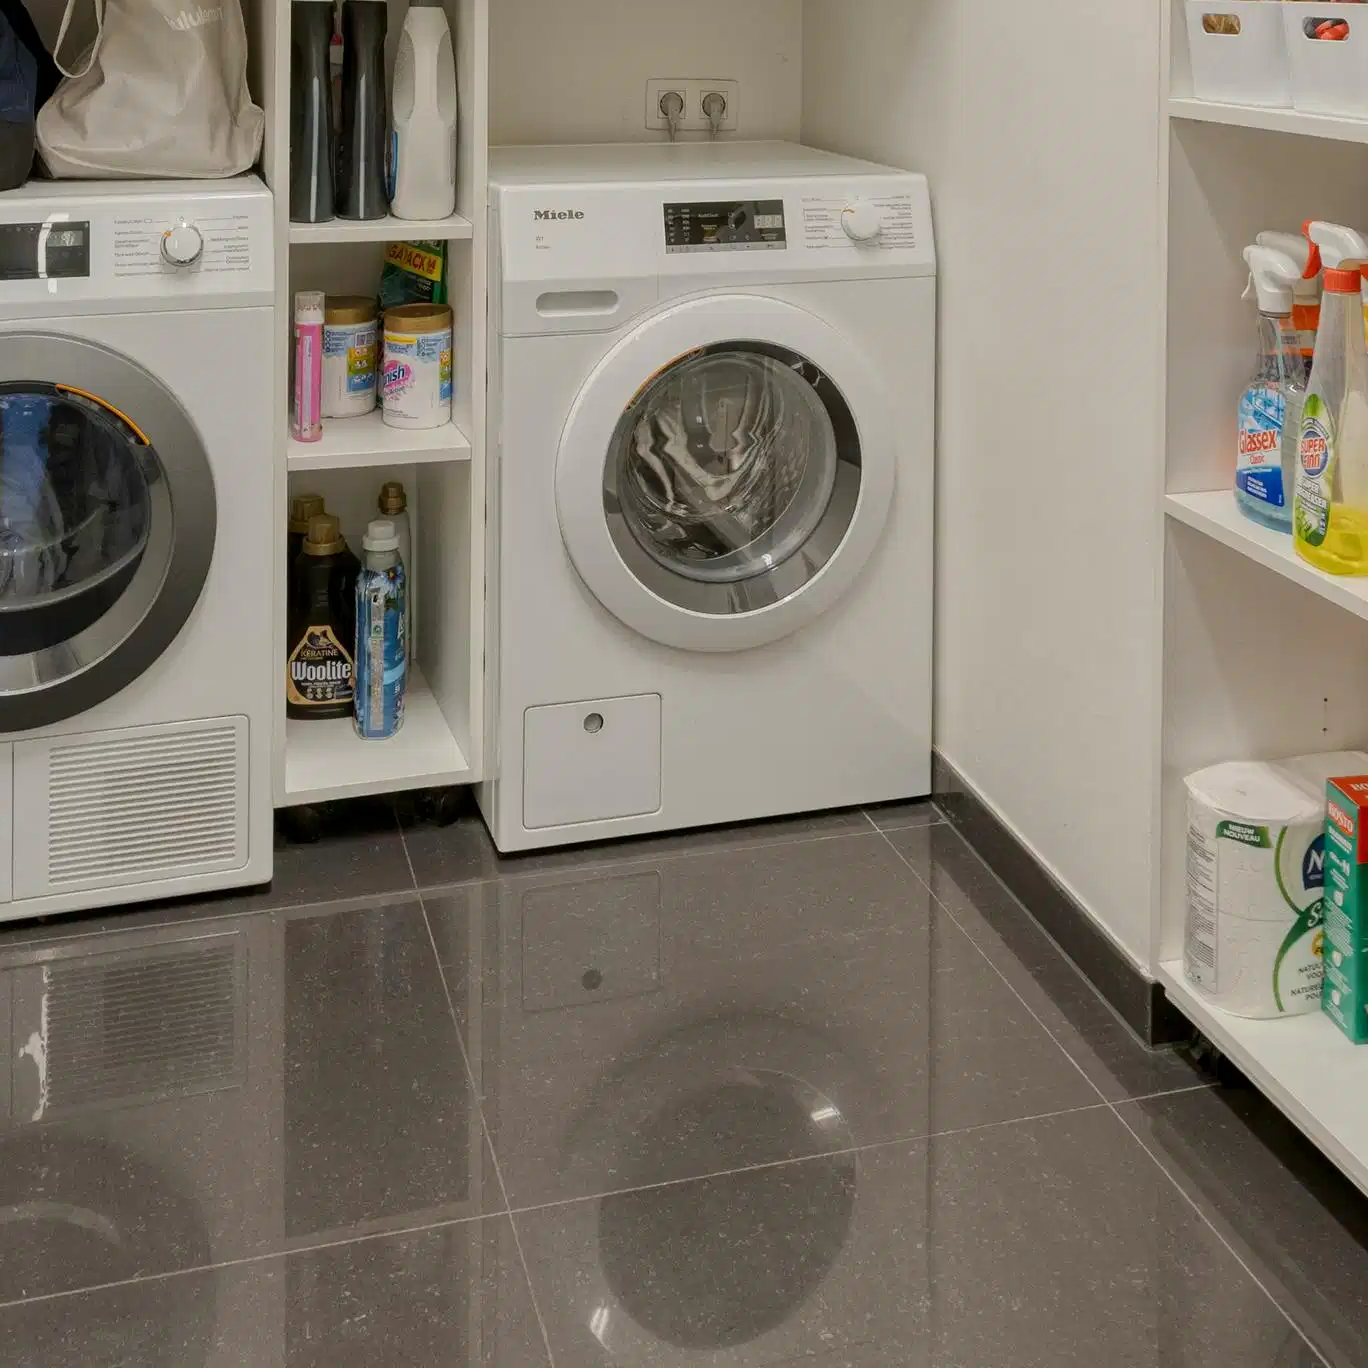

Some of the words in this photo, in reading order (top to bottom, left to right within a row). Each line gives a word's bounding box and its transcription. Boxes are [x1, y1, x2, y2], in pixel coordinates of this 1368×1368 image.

[534, 209, 585, 221] Miele
[1239, 430, 1277, 454] Glassex
[292, 660, 352, 681] Woolite
[1328, 801, 1354, 833] BOSTO
[1224, 828, 1260, 843] NOUVEAU
